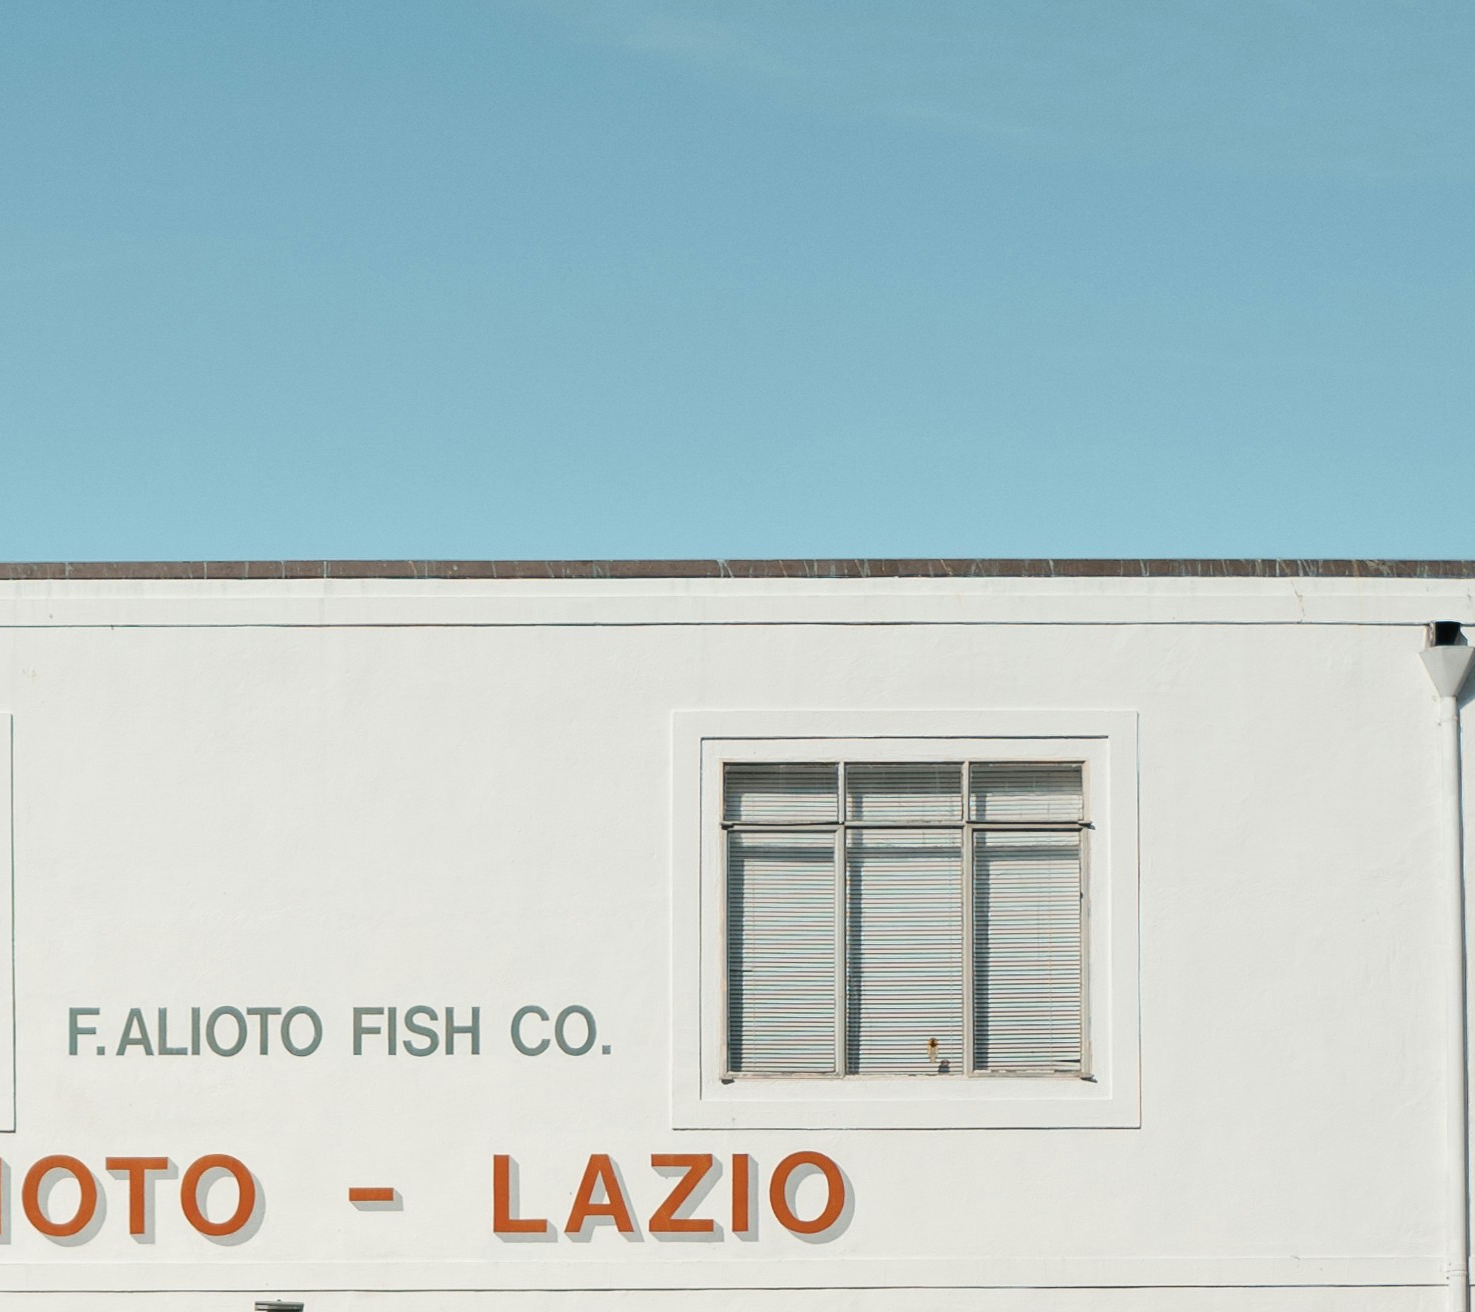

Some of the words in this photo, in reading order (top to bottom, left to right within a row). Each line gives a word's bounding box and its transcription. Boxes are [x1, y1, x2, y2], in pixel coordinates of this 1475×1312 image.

[353, 1005, 480, 1057] FISH
[510, 1005, 611, 1056] CO.
[493, 1150, 850, 1238] LAZIO
